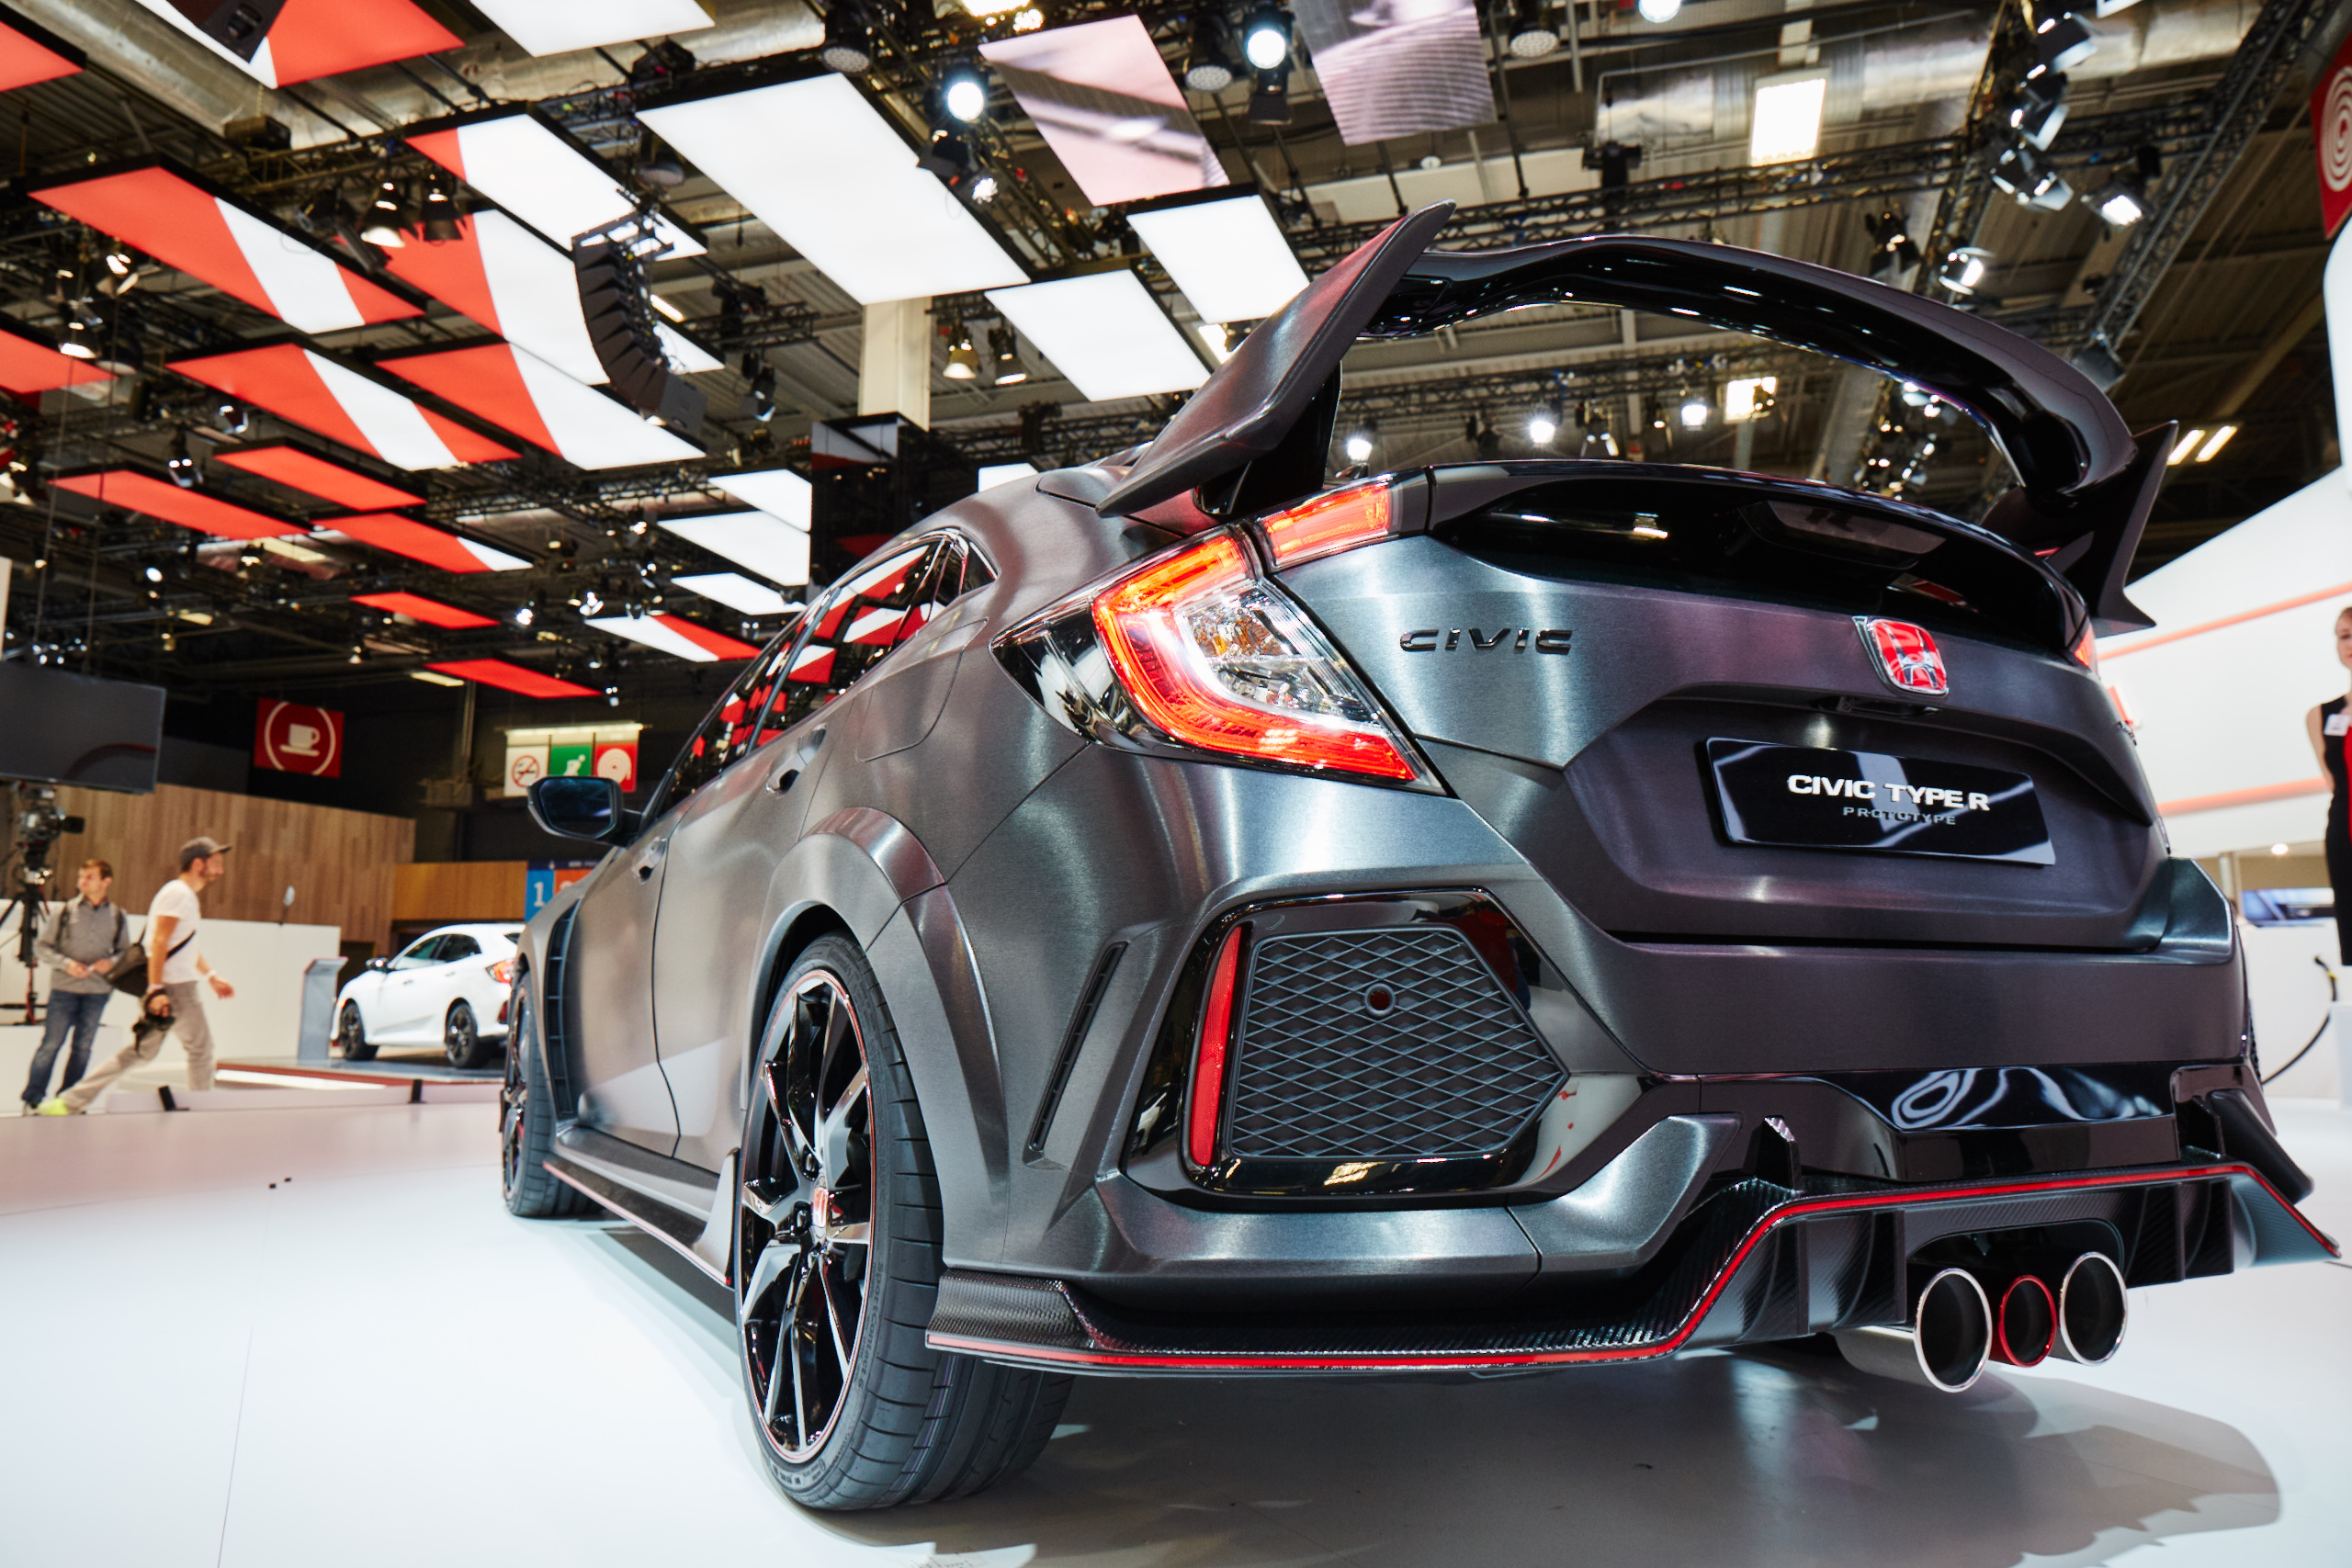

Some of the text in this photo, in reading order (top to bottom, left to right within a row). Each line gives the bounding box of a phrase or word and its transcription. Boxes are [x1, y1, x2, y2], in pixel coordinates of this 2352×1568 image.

[1399, 627, 1573, 654] CIVIC
[1787, 774, 1990, 811] CIVIC TYPE R
[1843, 806, 1956, 825] PROTOTYPE
